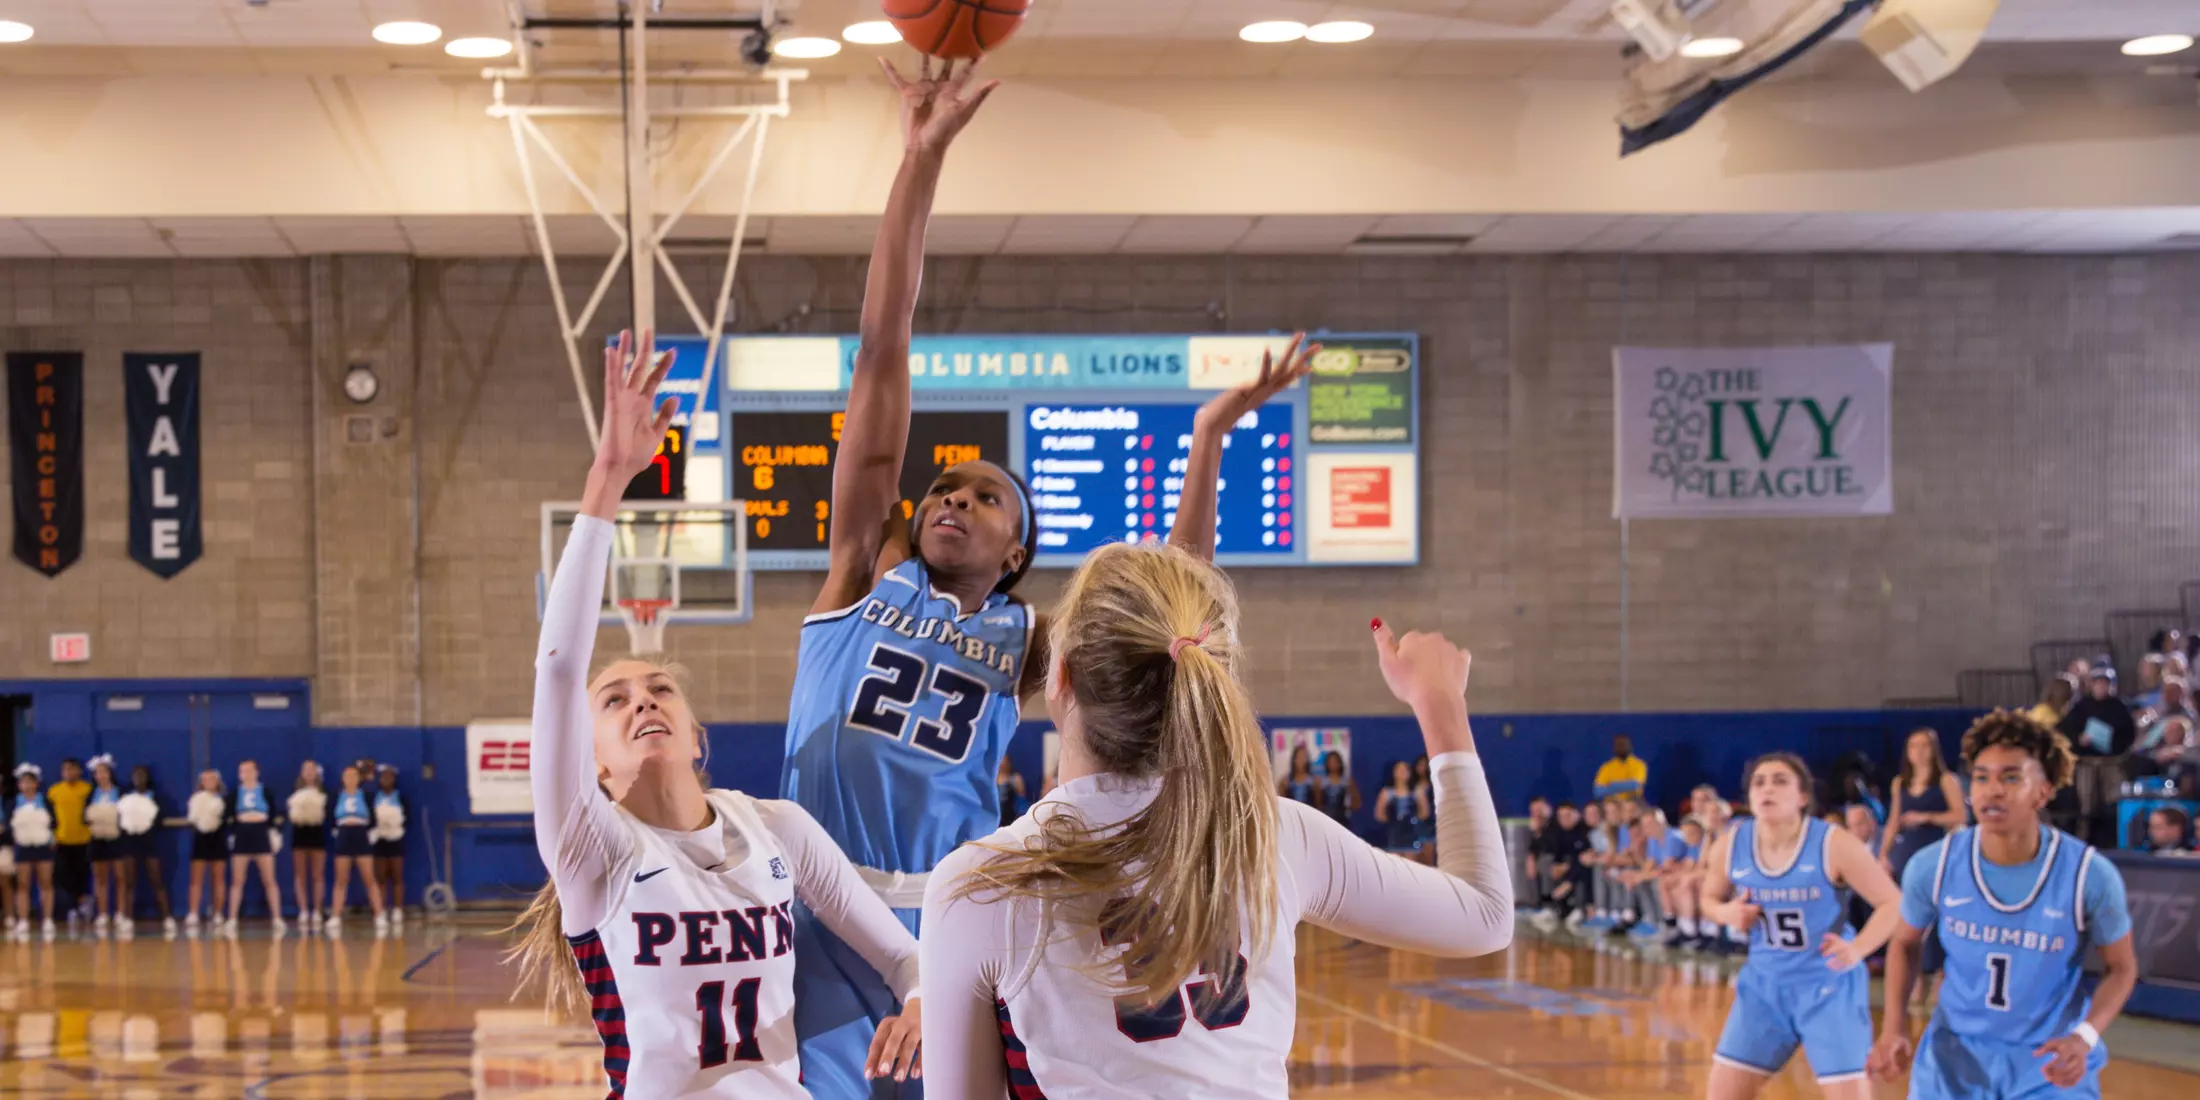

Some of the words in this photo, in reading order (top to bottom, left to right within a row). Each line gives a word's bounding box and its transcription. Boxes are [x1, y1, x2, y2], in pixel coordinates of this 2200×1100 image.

[908, 352, 1070, 377] OLUMBIA
[1090, 353, 1182, 375] LIONS
[1705, 367, 1761, 393] THE
[1030, 407, 1139, 431] Columbia
[1703, 397, 1849, 463] IVY
[35, 362, 59, 569] PRINCETON
[146, 364, 181, 559] YALE
[859, 598, 1017, 679] COLUMBIA
[845, 640, 991, 765] 23
[479, 740, 531, 772] ES
[631, 900, 794, 967] PENN
[1943, 914, 2065, 953] COLUMBIA
[1985, 951, 2012, 1012] 1
[695, 976, 765, 1071] 11
